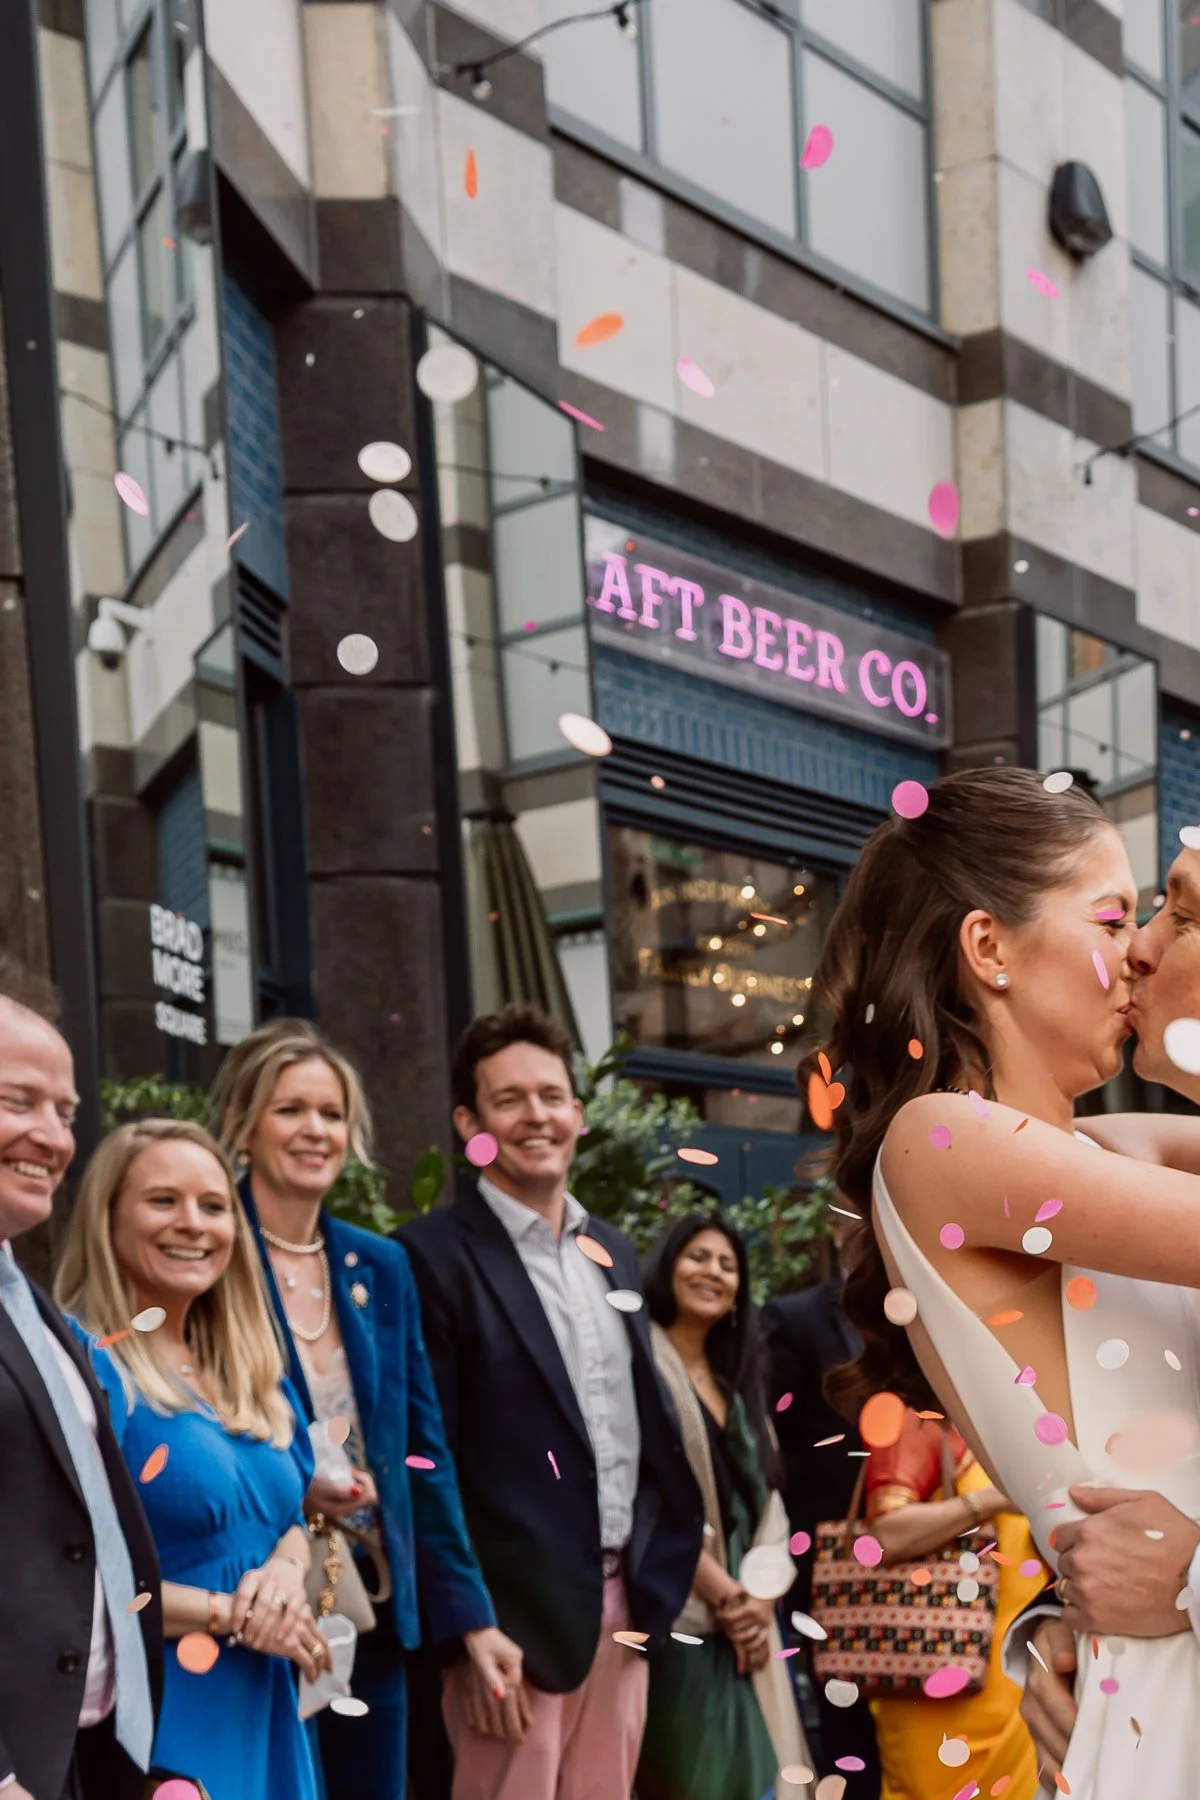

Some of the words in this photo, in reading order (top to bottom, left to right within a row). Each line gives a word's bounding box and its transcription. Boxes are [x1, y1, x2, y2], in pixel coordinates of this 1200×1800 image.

[594, 551, 705, 643] AFT
[717, 593, 849, 694] BEER
[858, 648, 939, 724] CO.
[149, 903, 204, 962] BRAD
[152, 947, 206, 1004] MORE
[154, 1001, 208, 1046] SQUARE
